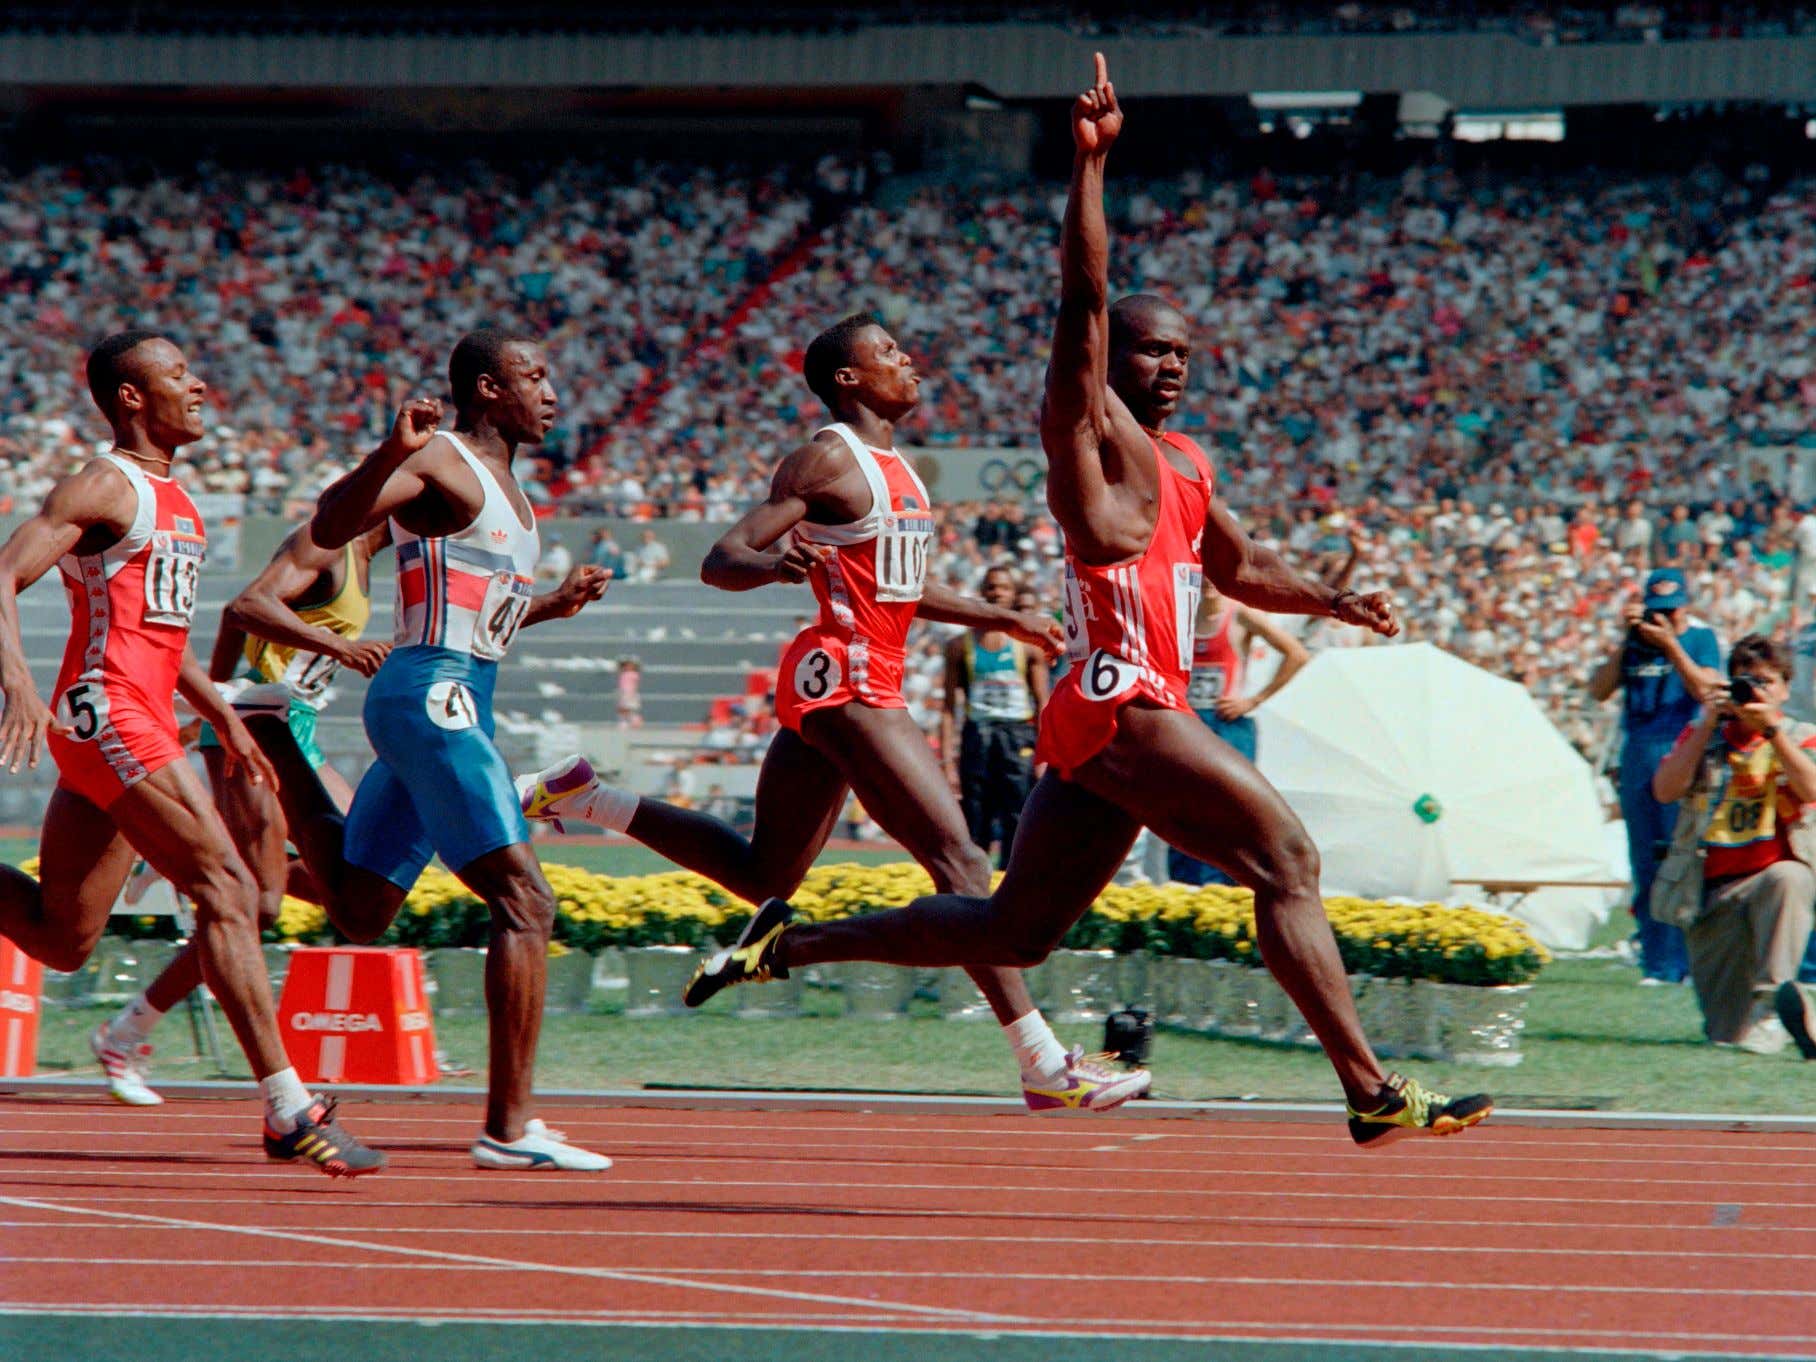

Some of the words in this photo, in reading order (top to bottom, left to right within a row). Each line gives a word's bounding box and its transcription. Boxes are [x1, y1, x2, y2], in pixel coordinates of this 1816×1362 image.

[803, 651, 831, 699] 3
[1092, 649, 1119, 696] 6
[66, 684, 99, 740] 5
[445, 684, 473, 725] 4
